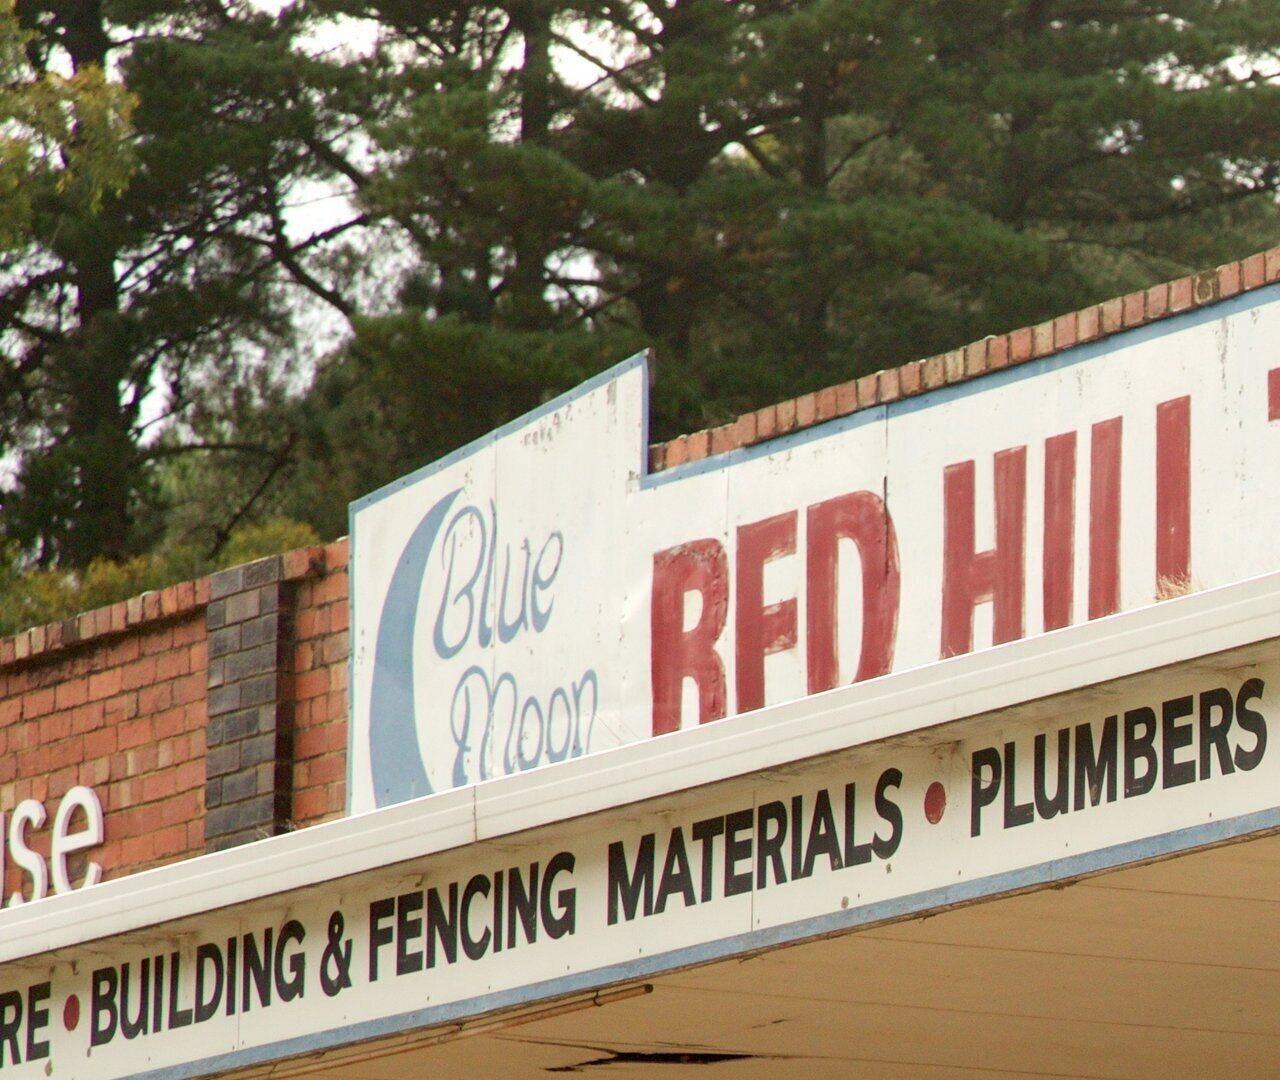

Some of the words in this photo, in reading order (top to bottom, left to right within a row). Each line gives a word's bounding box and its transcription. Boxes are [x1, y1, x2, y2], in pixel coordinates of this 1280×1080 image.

[432, 489, 565, 660] Blue
[650, 490, 901, 736] RED
[449, 665, 600, 788] Moon
[0, 785, 104, 908] se
[91, 920, 306, 1047] BUILDING
[320, 910, 352, 997] &
[369, 851, 576, 981] FENCING
[607, 767, 903, 925] MATERIALS
[970, 678, 1268, 837] PLUMBERS
